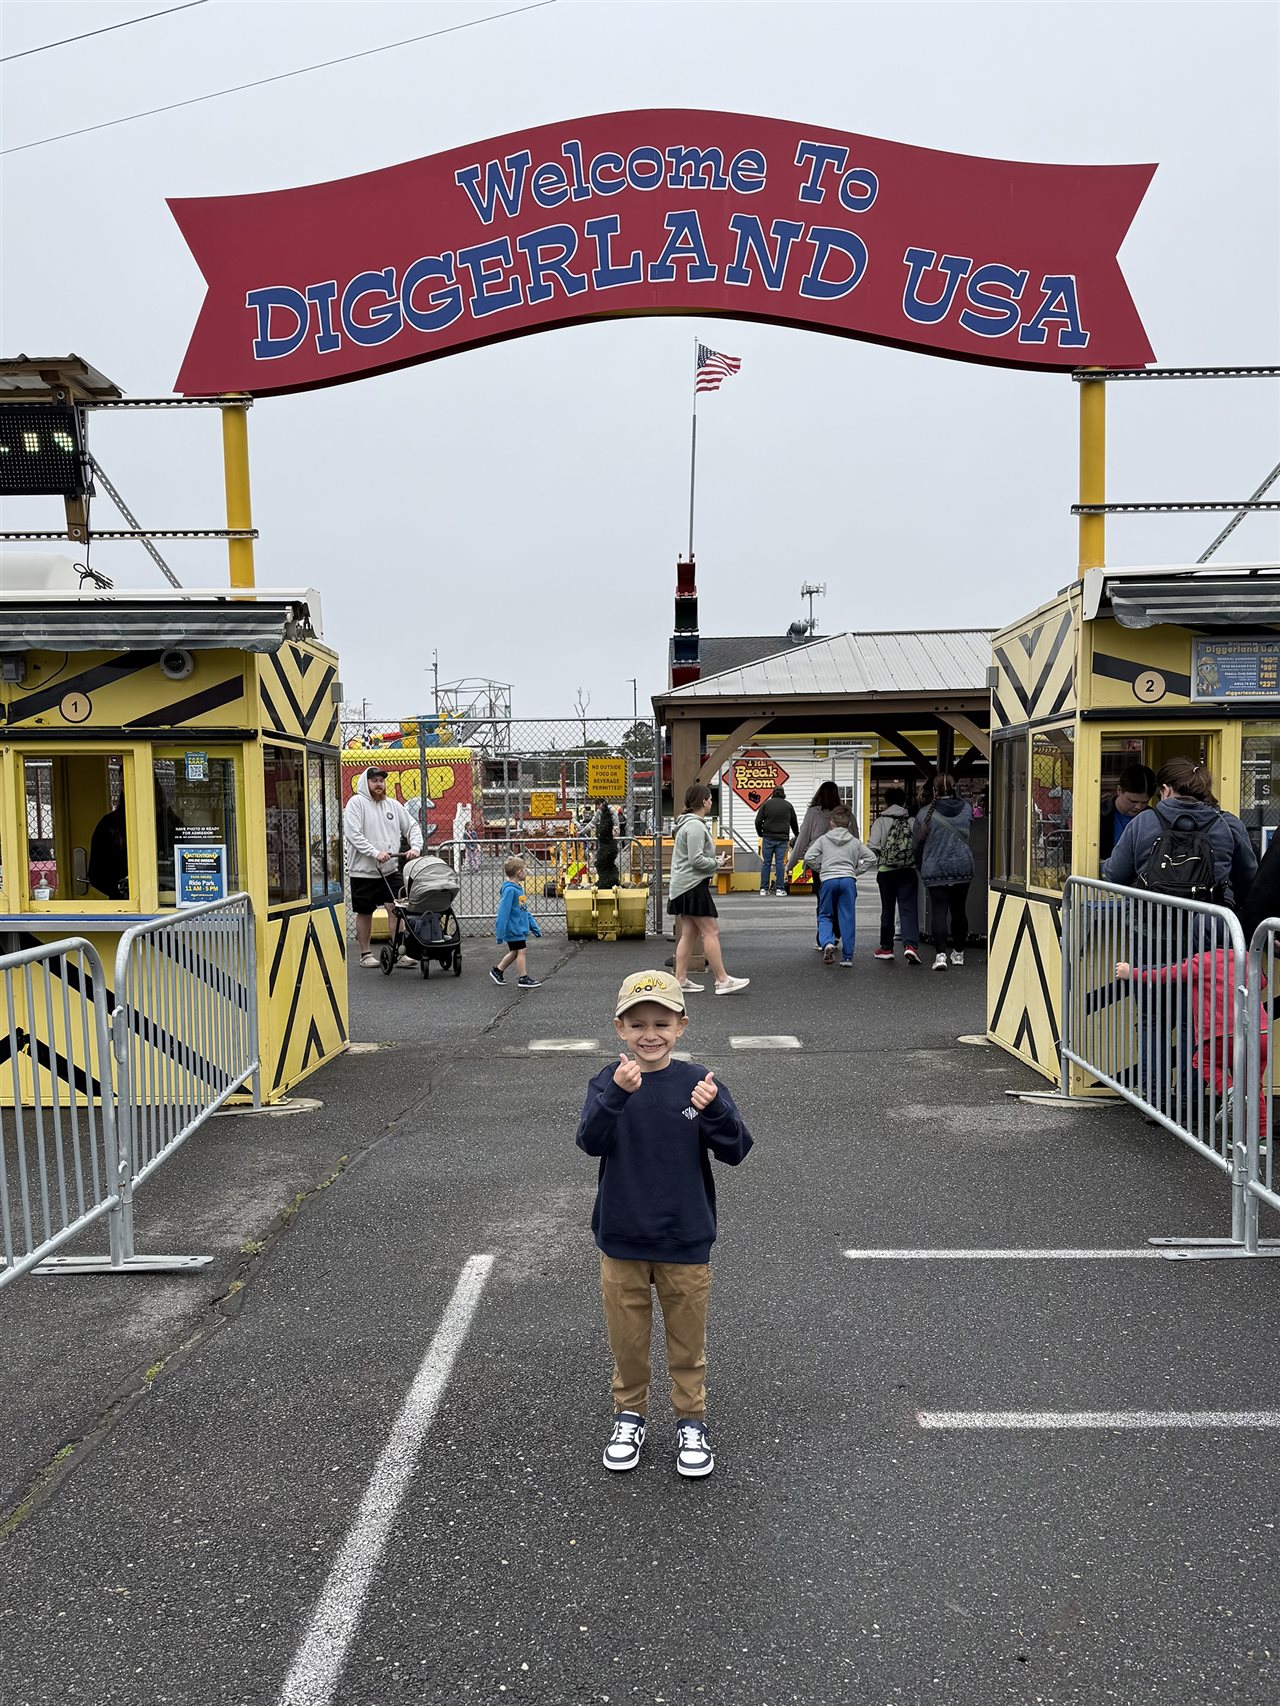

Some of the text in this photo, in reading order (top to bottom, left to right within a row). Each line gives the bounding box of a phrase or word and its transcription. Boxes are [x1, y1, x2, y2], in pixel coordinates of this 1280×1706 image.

[454, 139, 879, 225] Welcome To
[244, 208, 1091, 362] DIGGERLAND USA
[1205, 645, 1280, 655] Diggerland USA
[1146, 680, 1154, 692] 2
[72, 700, 78, 713] 1
[734, 765, 778, 778] Break
[736, 776, 776, 789] Room
